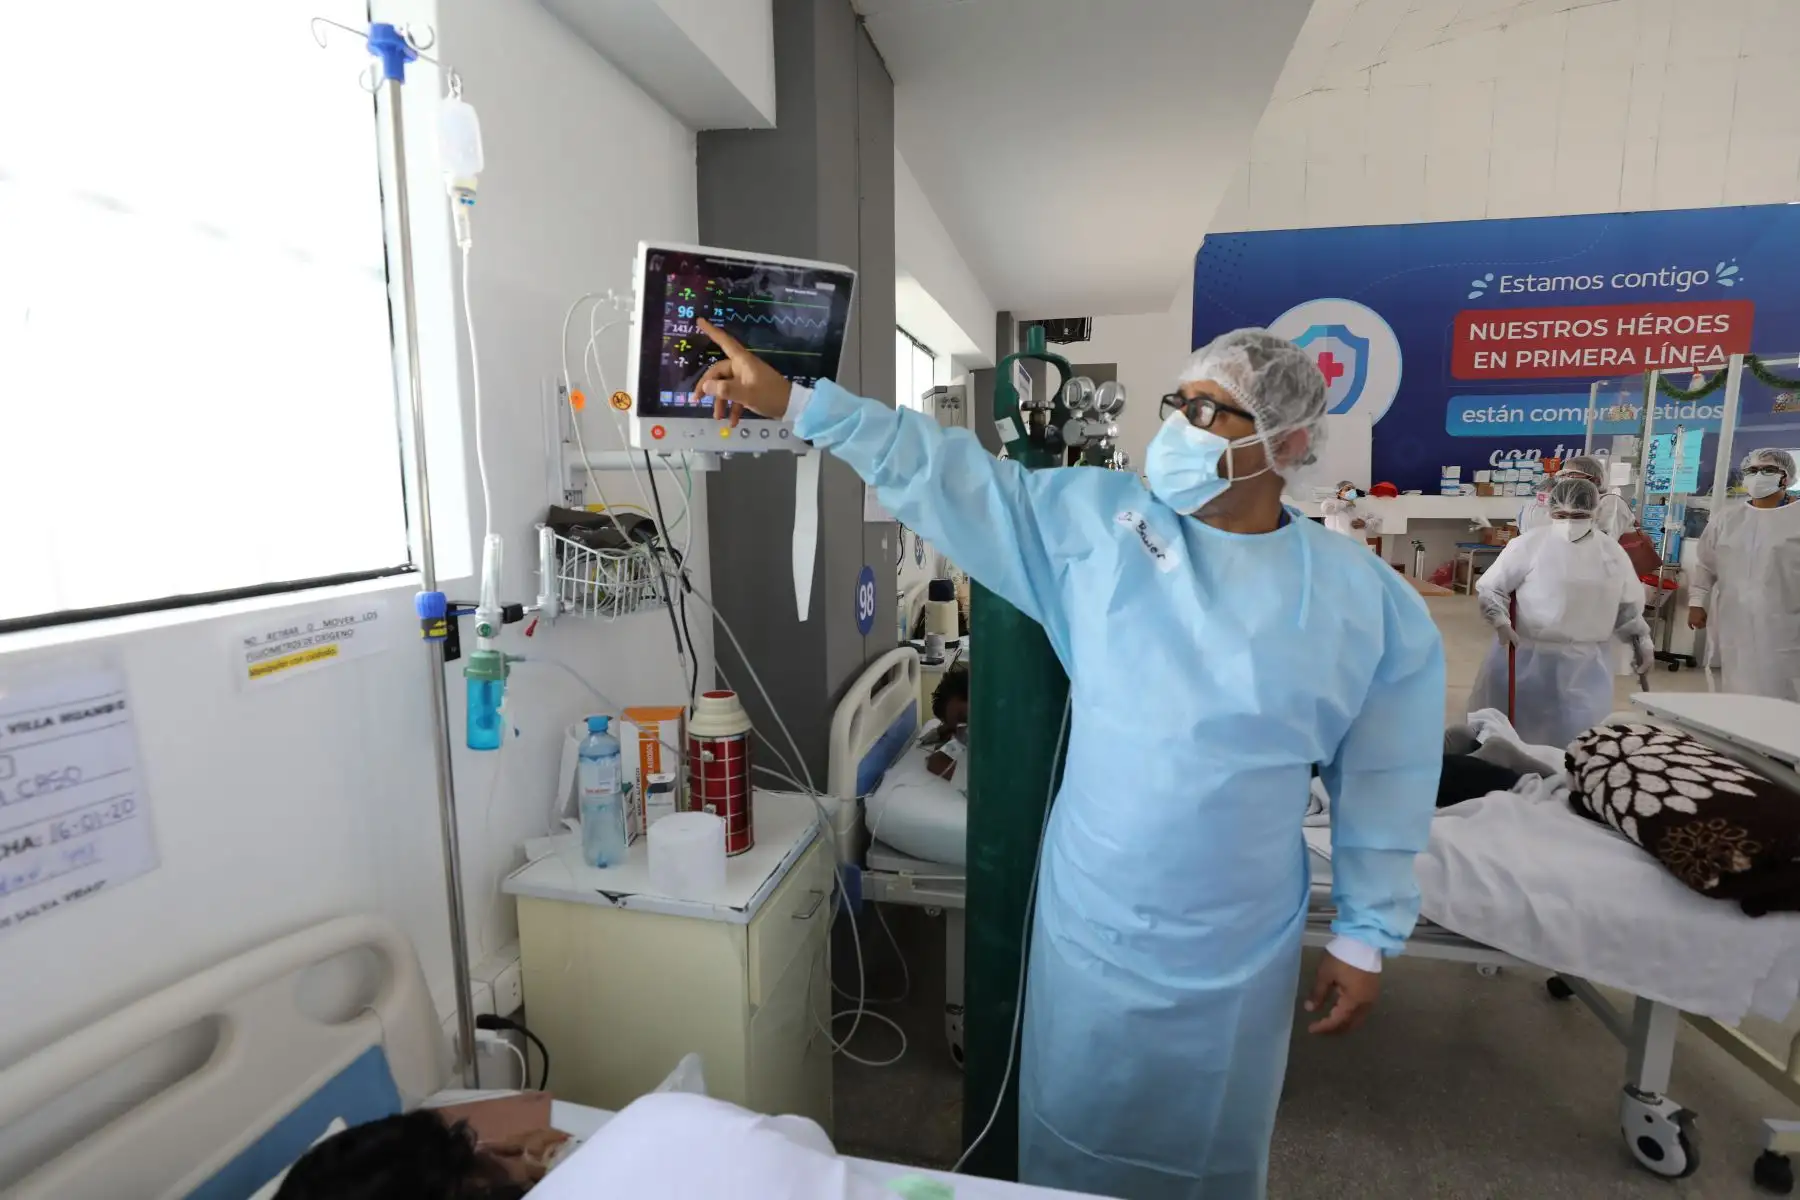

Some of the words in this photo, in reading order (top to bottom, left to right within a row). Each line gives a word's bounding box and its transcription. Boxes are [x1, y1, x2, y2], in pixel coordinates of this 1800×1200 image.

[1500, 272, 1604, 294] Estamos
[1611, 265, 1709, 293] contigo
[677, 305, 694, 318] 96
[1469, 317, 1608, 341] NUESTROS
[1617, 312, 1731, 336] HÉROES
[1473, 350, 1508, 370] EN
[1516, 347, 1635, 369] PRIMERA
[1644, 341, 1726, 365] LÍNEA
[1462, 404, 1524, 423] están
[1530, 400, 1725, 426] compretidos
[859, 581, 874, 621] 98
[322, 615, 355, 628] MOVER
[362, 610, 378, 622] LOS
